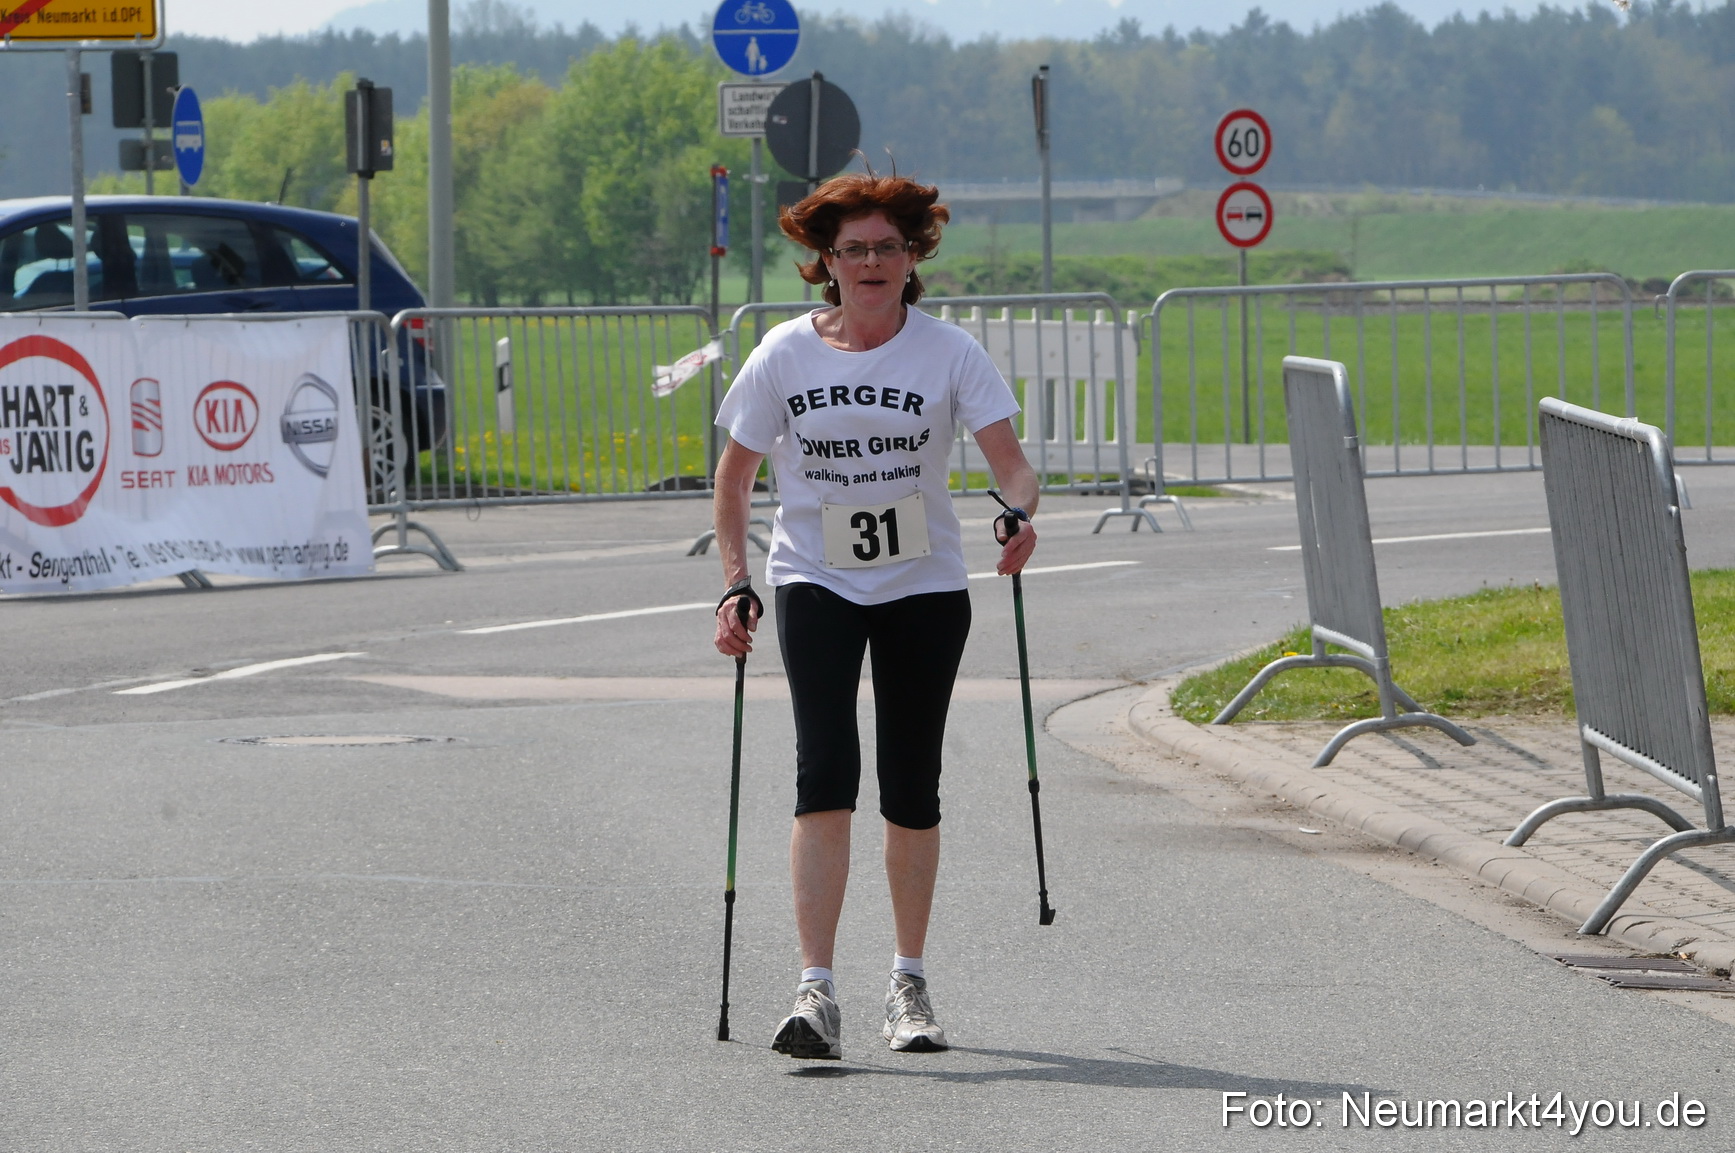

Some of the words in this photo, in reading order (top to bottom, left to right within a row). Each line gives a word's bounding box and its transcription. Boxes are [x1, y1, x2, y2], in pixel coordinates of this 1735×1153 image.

[37, 8, 97, 24] Neumarkt
[1228, 128, 1259, 157] 60
[0, 385, 74, 428] HART
[787, 385, 924, 417] BERGER
[205, 399, 246, 433] KIA
[286, 416, 338, 436] NISSA
[9, 430, 94, 475] JÄNIG
[868, 428, 930, 455] GIRLS
[121, 470, 176, 489] SEAT
[187, 465, 209, 487] KIA
[214, 462, 275, 486] MOTORS
[805, 469, 849, 486] walking
[853, 470, 877, 484] and
[881, 464, 921, 481] talking
[850, 507, 900, 562] 31
